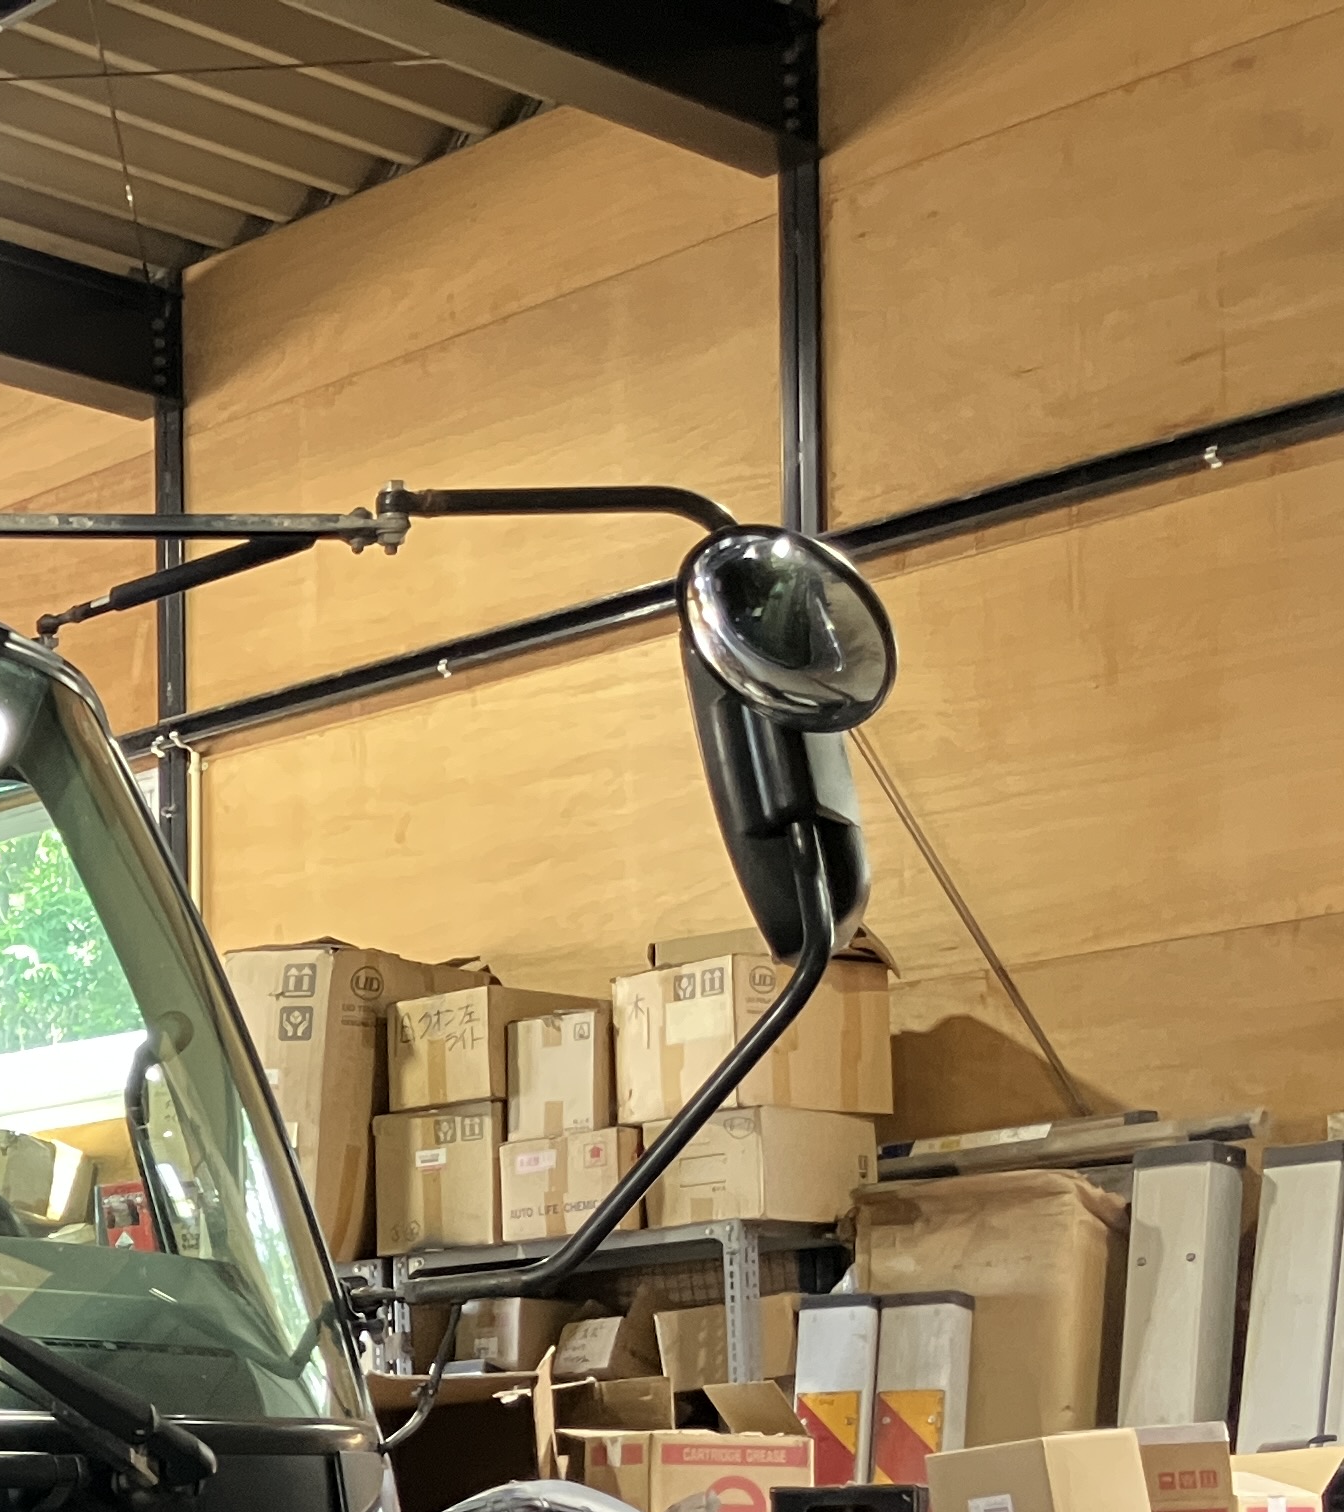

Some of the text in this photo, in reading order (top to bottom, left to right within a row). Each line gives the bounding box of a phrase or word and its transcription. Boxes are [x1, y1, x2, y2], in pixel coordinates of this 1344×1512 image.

[445, 1026, 484, 1051] ライト
[511, 1199, 602, 1219] AUTO LIFE CHEMIC
[746, 1448, 787, 1463] GREASE
